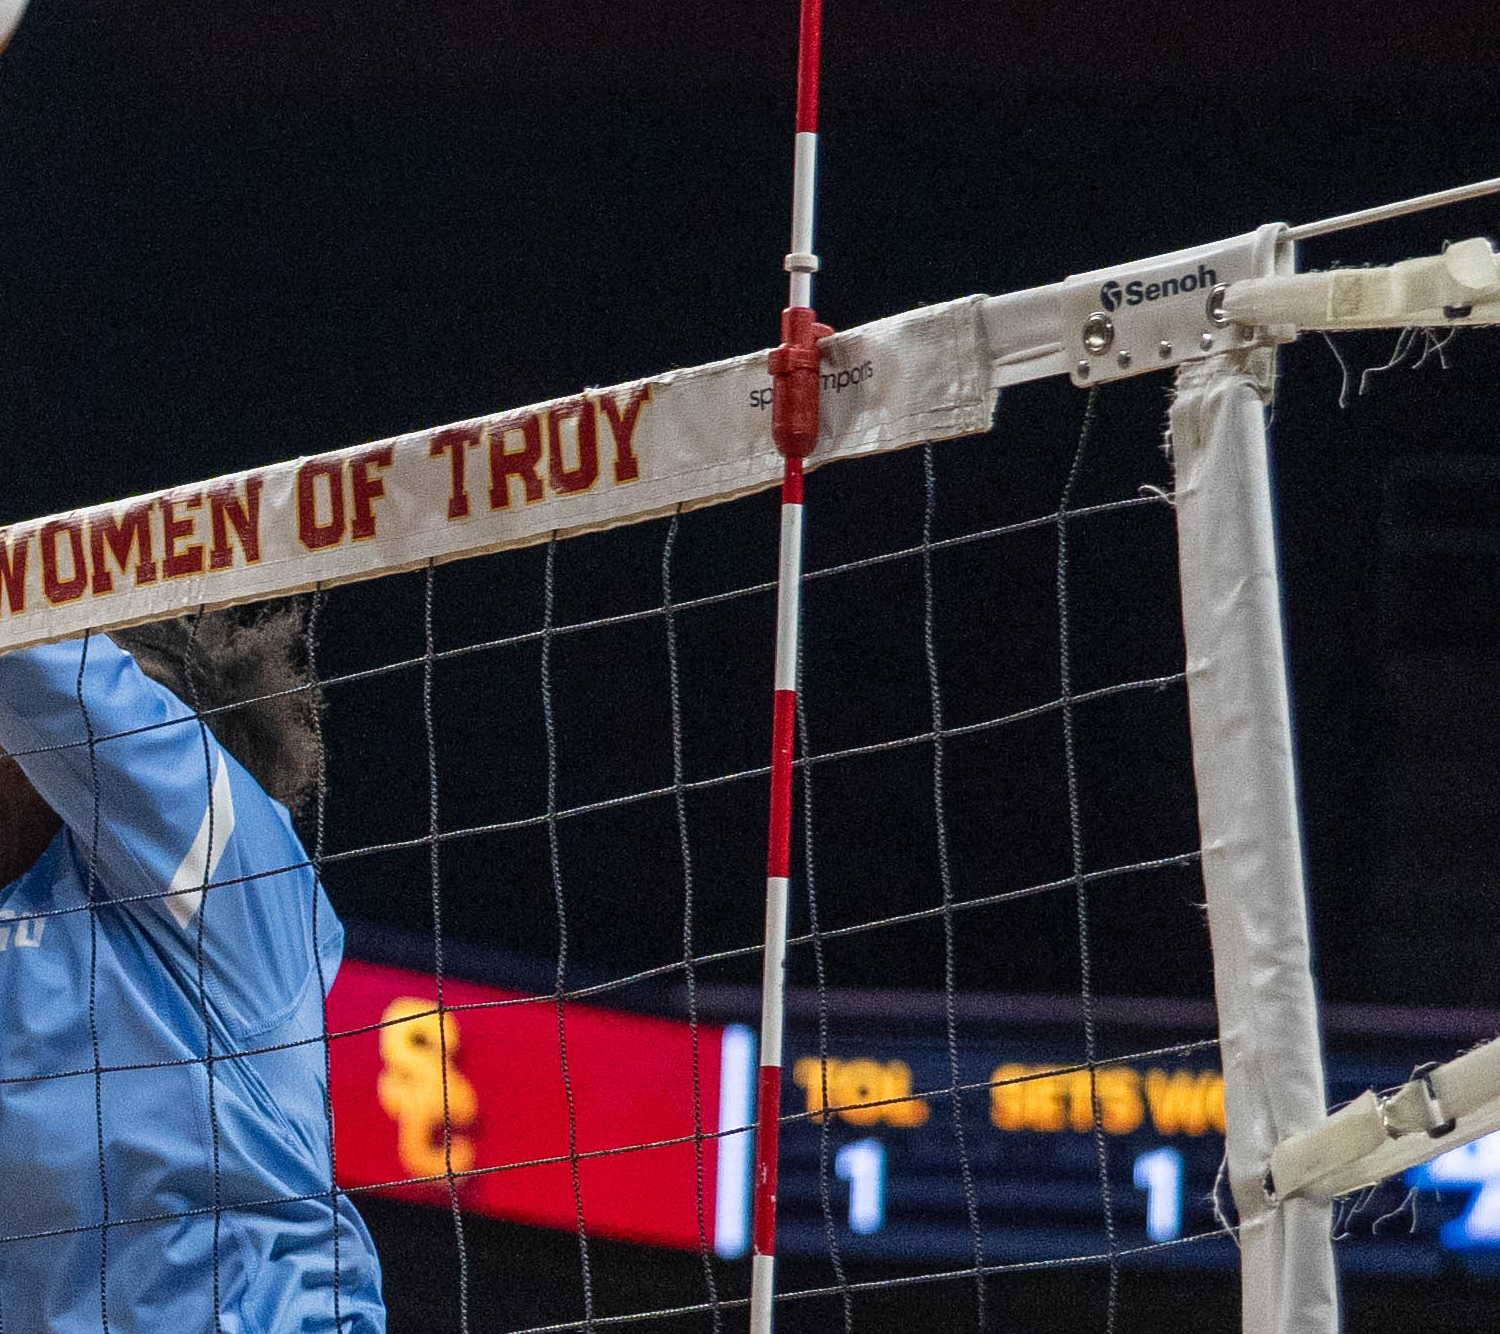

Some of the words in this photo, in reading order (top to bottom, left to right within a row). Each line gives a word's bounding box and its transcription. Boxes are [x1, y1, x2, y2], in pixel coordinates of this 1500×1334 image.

[1125, 265, 1217, 307] Senoh
[298, 448, 393, 552] OF
[430, 383, 655, 521] TROY
[835, 1137, 887, 1235] 1
[1133, 1147, 1184, 1242] 1
